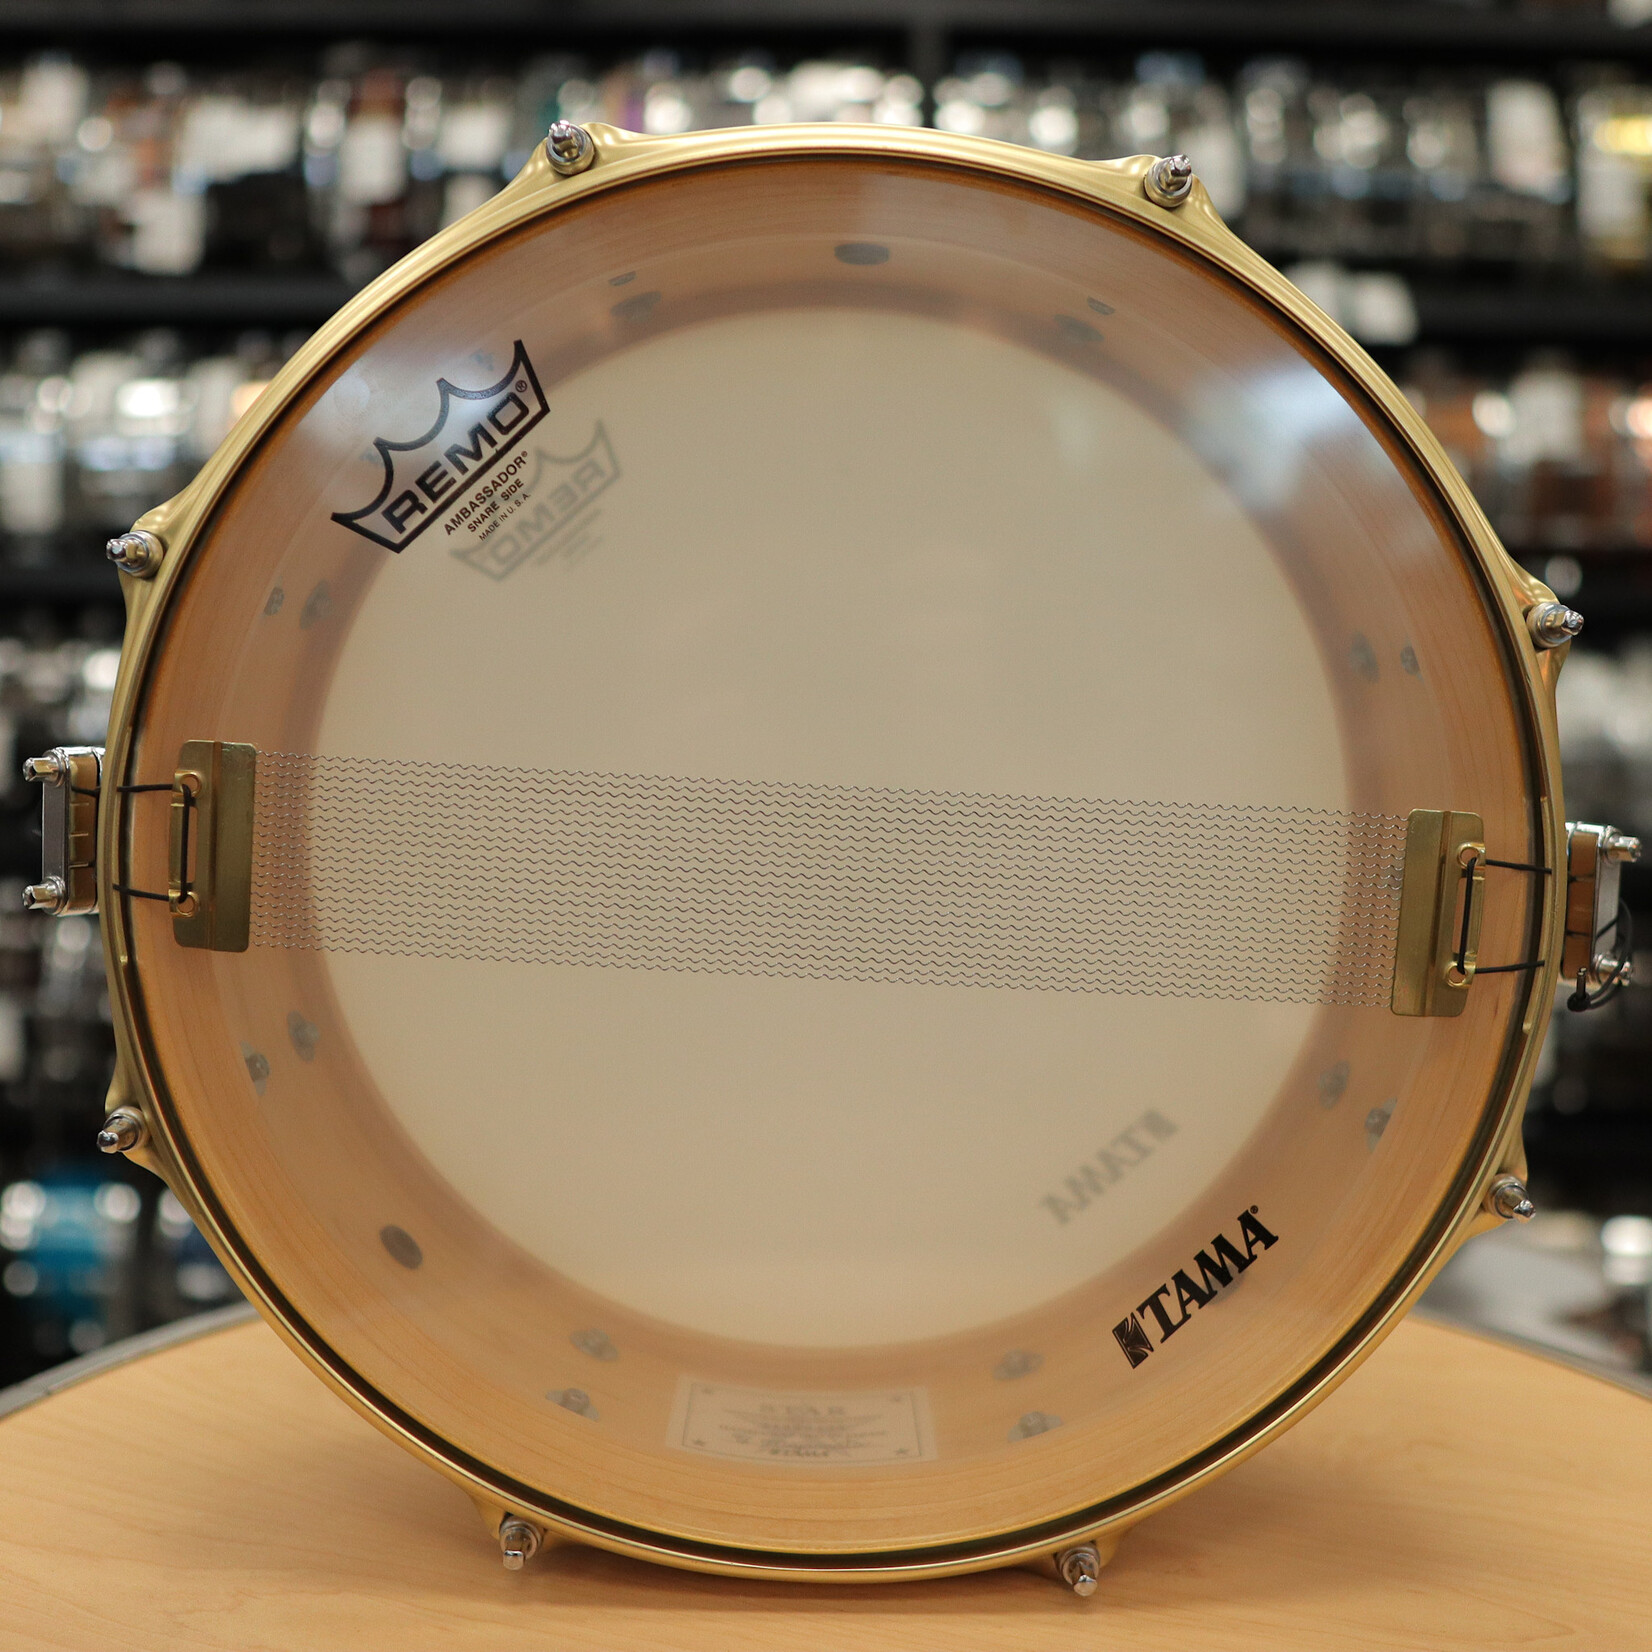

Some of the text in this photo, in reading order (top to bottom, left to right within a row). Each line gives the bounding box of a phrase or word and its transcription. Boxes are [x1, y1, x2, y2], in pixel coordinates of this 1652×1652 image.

[381, 391, 530, 534] REMO
[444, 456, 526, 535] AMBASSADOR
[467, 478, 524, 532] SNARE SIDE
[479, 520, 500, 541] MADE
[500, 512, 508, 522] IN
[1136, 1209, 1279, 1343] TAMA
